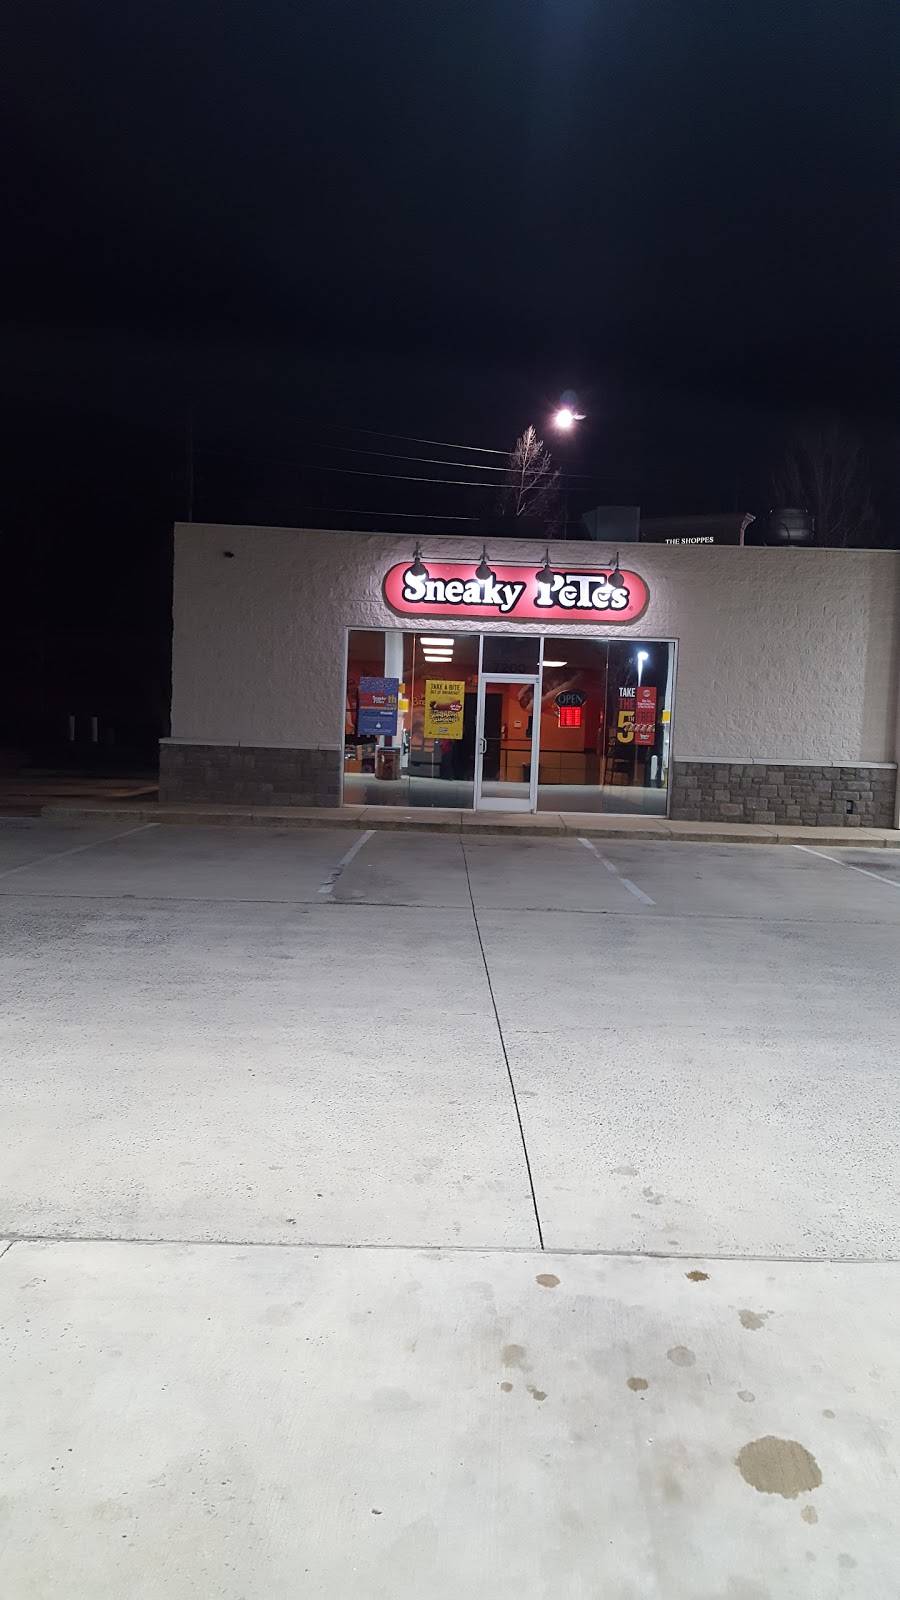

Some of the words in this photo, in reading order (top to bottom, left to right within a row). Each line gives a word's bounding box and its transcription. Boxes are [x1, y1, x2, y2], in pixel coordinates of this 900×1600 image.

[681, 536, 714, 545] SHOPPES
[403, 571, 524, 612] Sneaky
[619, 687, 635, 697] TAKE
[558, 693, 583, 705] OPEN
